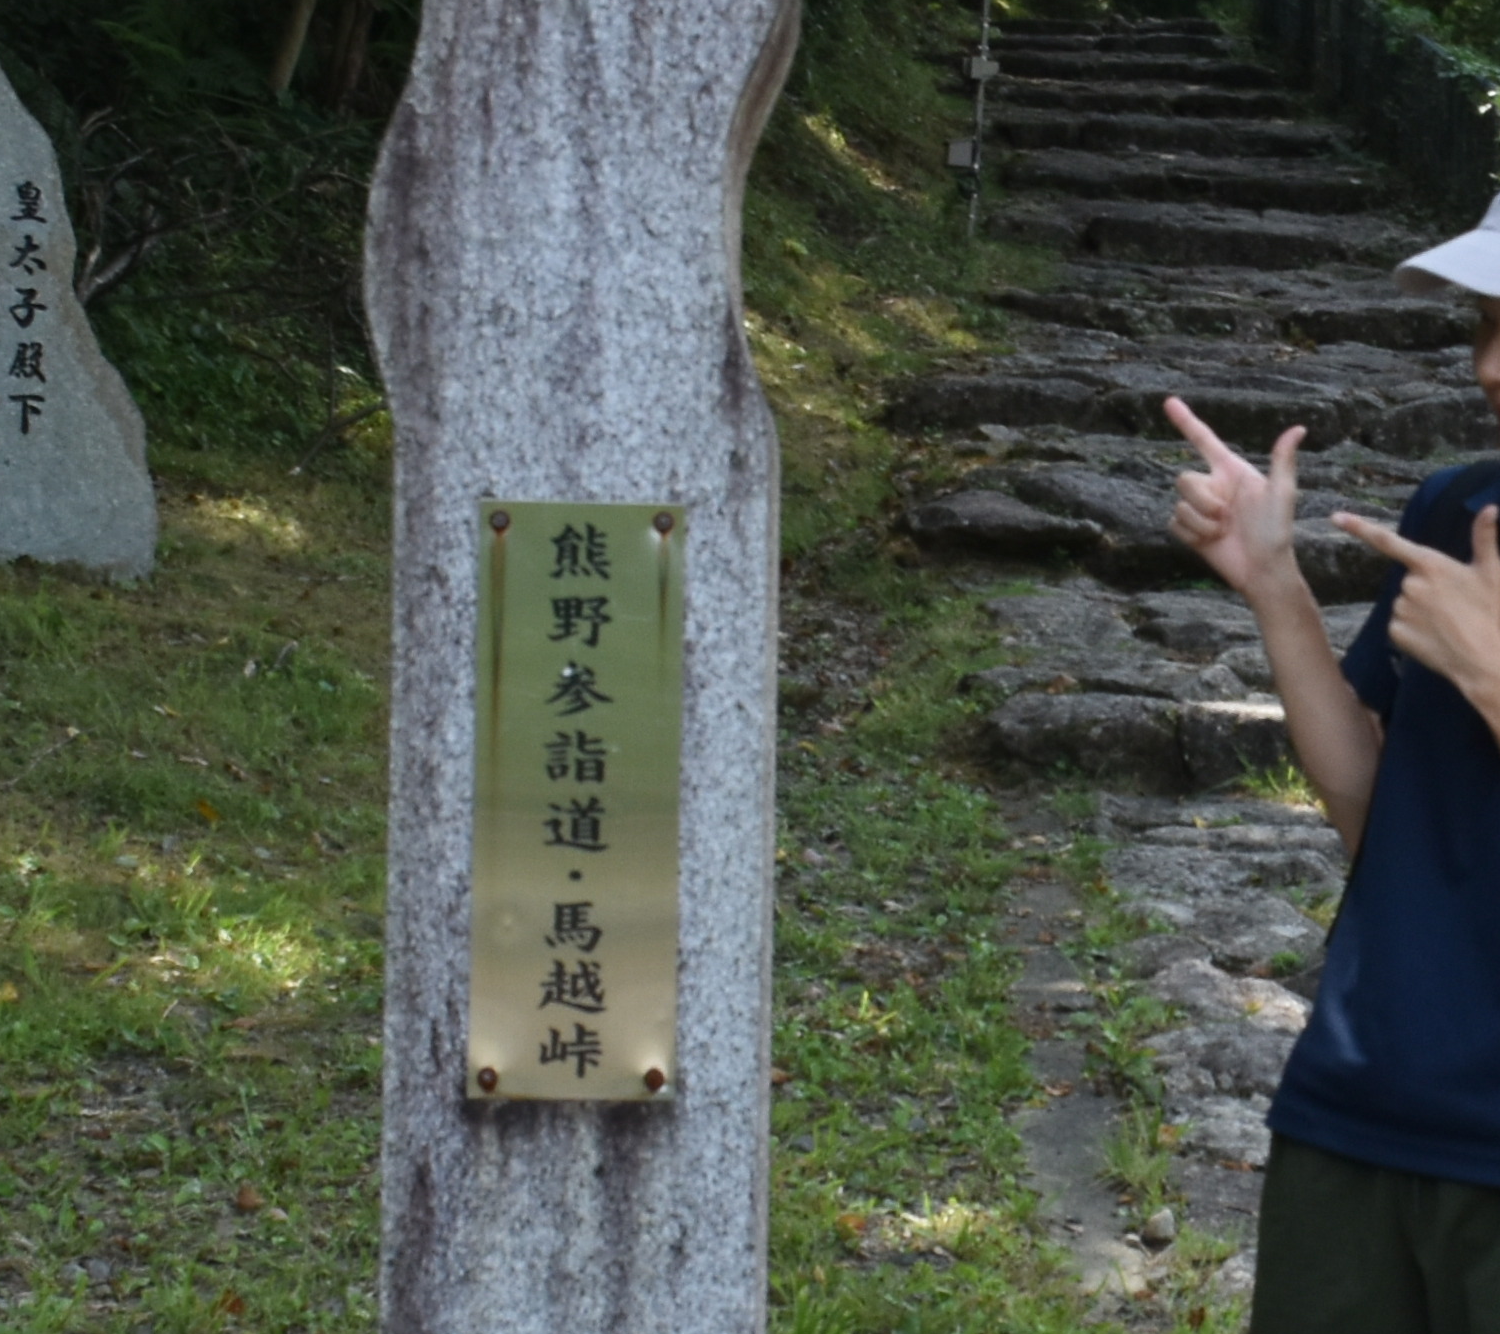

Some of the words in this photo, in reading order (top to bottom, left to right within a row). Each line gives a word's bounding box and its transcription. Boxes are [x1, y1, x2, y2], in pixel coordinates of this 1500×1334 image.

[7, 179, 49, 436] 皇太子殿下
[538, 521, 614, 1079] 熊野参詣道・馬越峠
